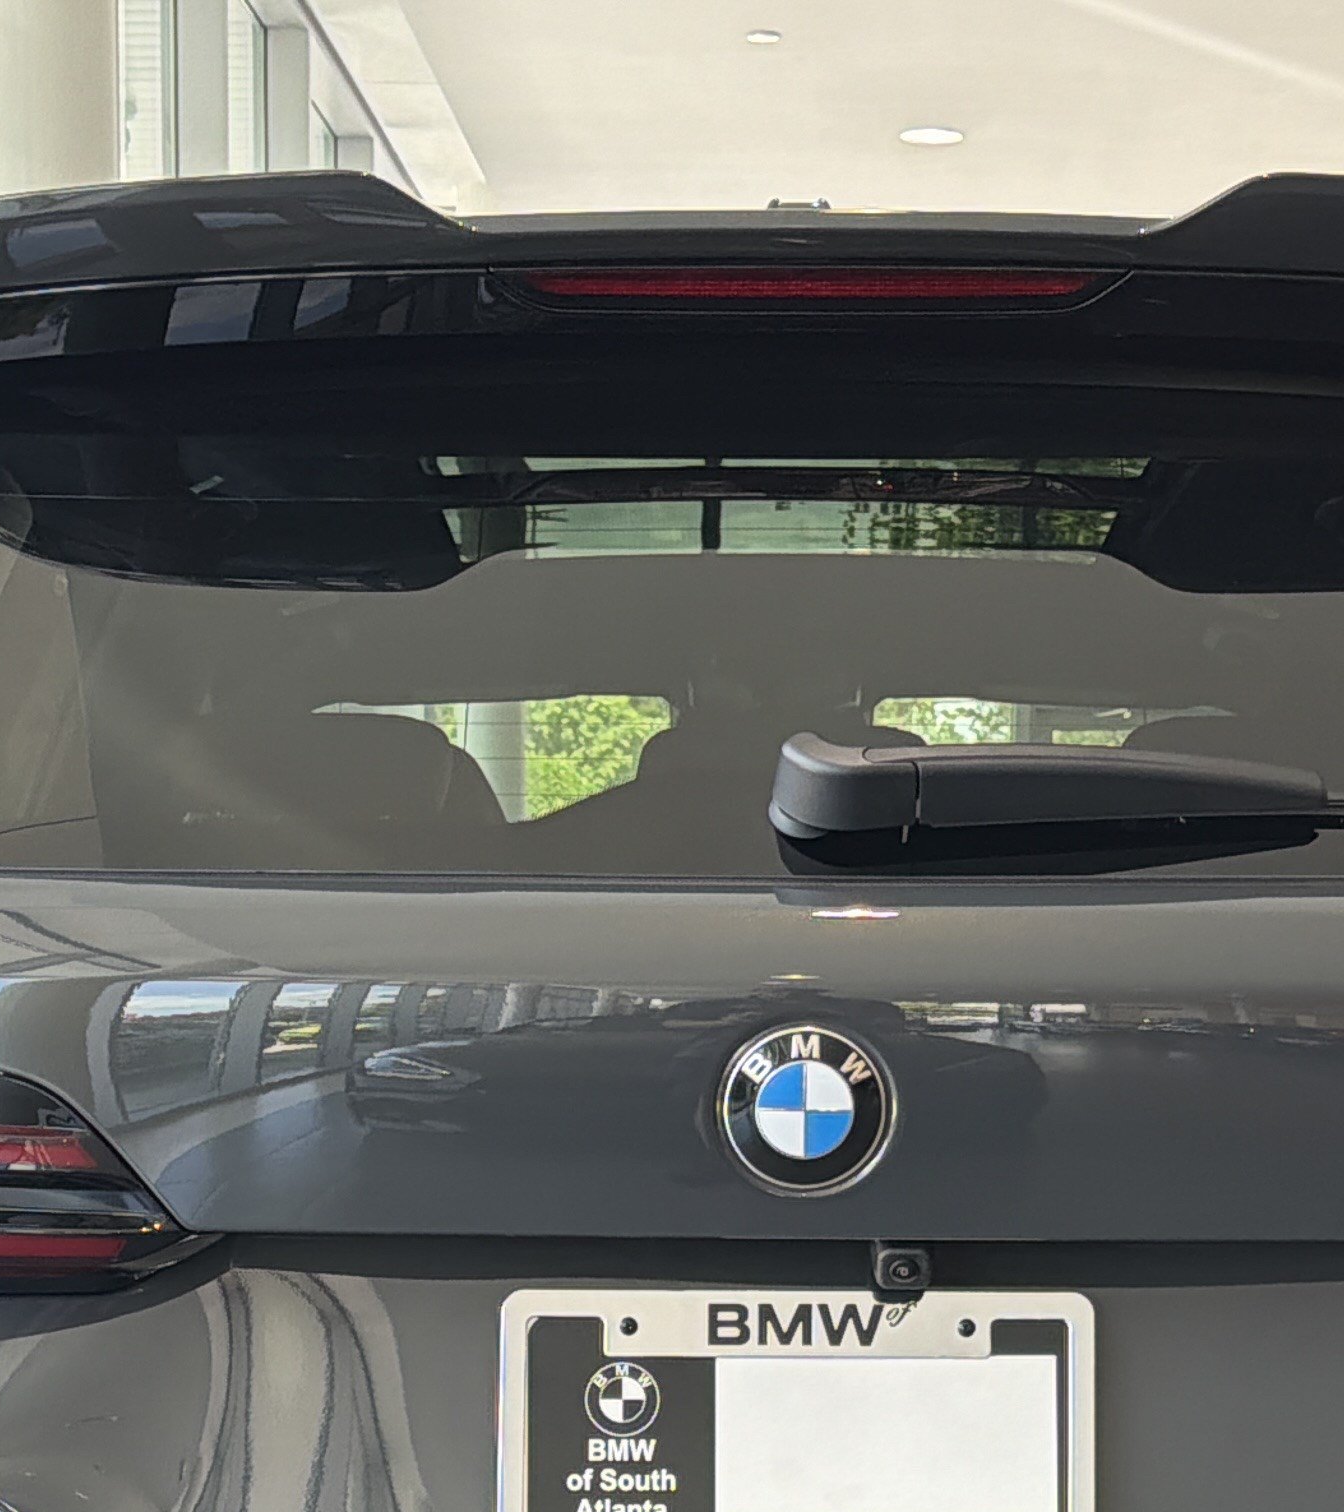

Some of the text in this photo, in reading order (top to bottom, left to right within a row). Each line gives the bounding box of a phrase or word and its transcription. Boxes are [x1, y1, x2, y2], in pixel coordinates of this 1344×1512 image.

[740, 1033, 872, 1086] BMW
[707, 1301, 918, 1347] BMW of
[592, 1363, 654, 1389] BMW
[587, 1438, 658, 1462] BMW
[565, 1468, 678, 1492] of South
